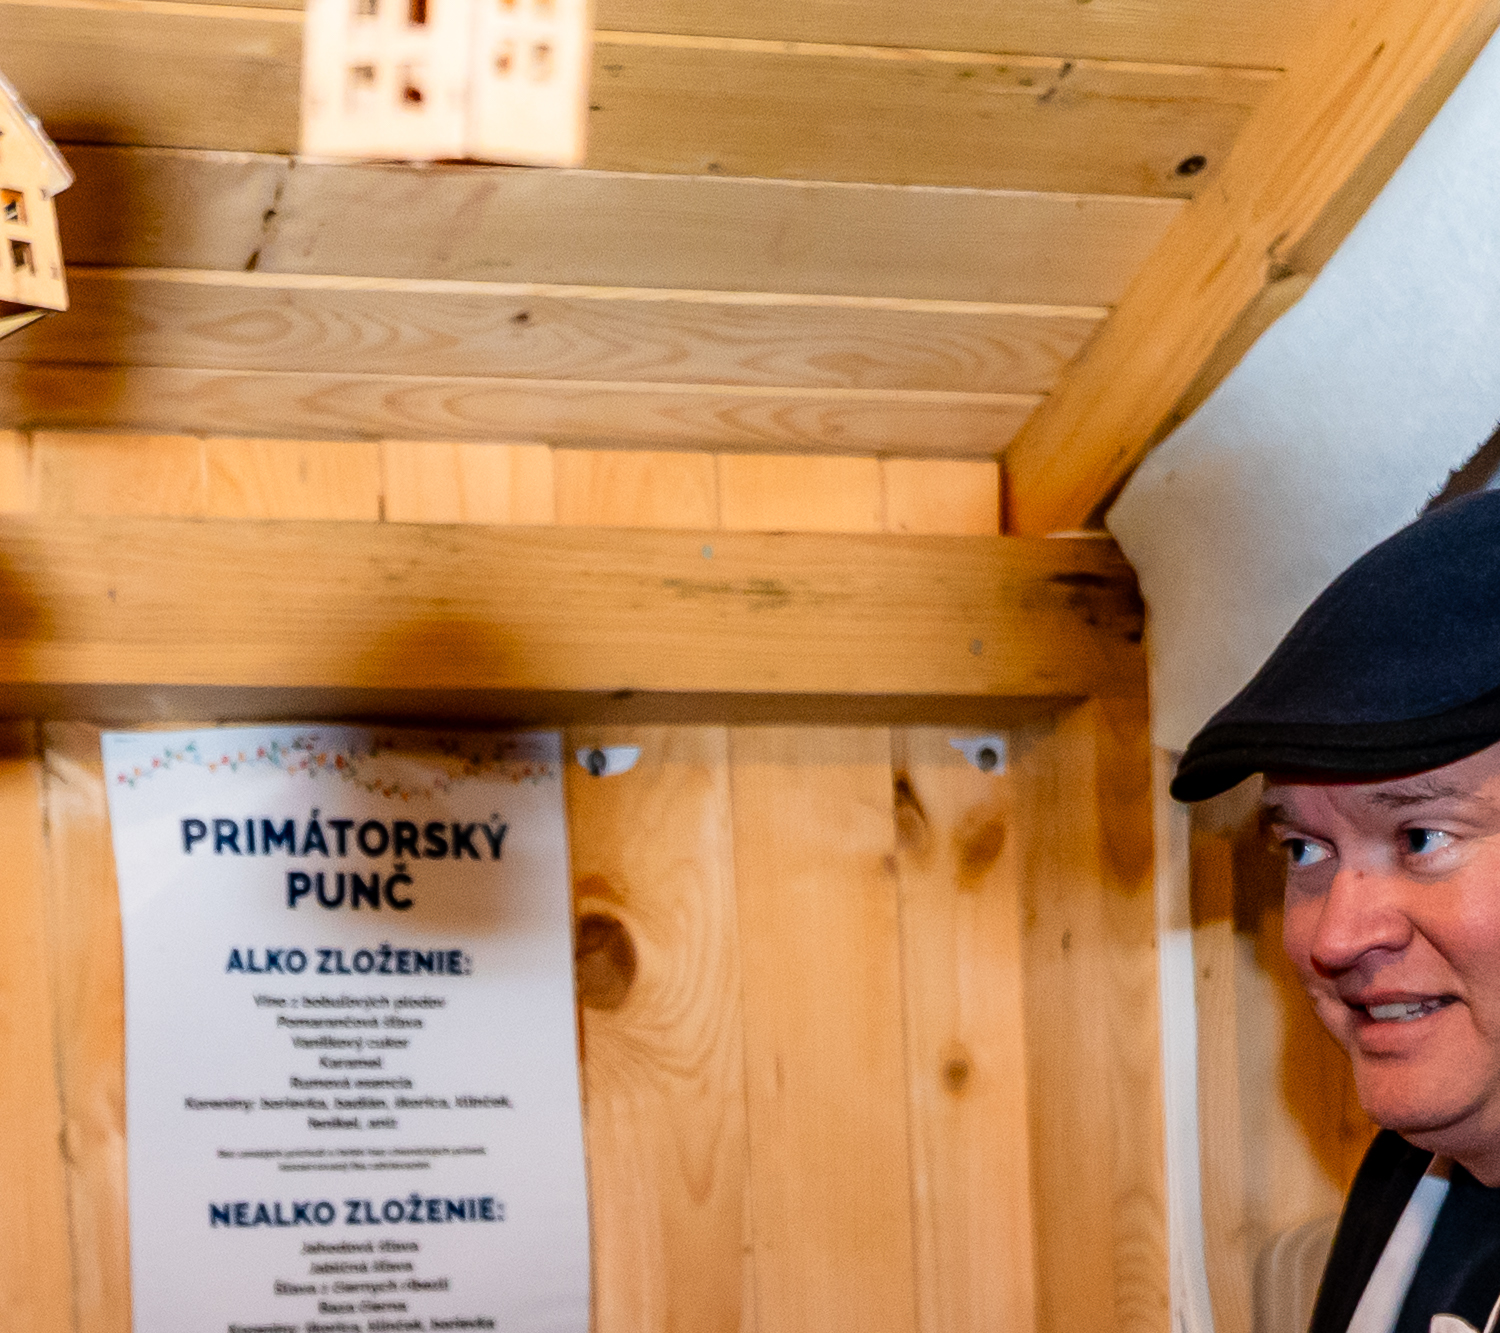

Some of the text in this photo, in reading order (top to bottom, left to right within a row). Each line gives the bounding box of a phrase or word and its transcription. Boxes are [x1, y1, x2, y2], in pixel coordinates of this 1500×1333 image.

[180, 807, 508, 861] PRIMÁTORSKÝ
[286, 863, 415, 911] PUNČ
[225, 942, 473, 976] ALKO ZLOŽENIE:
[208, 1193, 504, 1228] NEALKO ZLOŽENIE:
